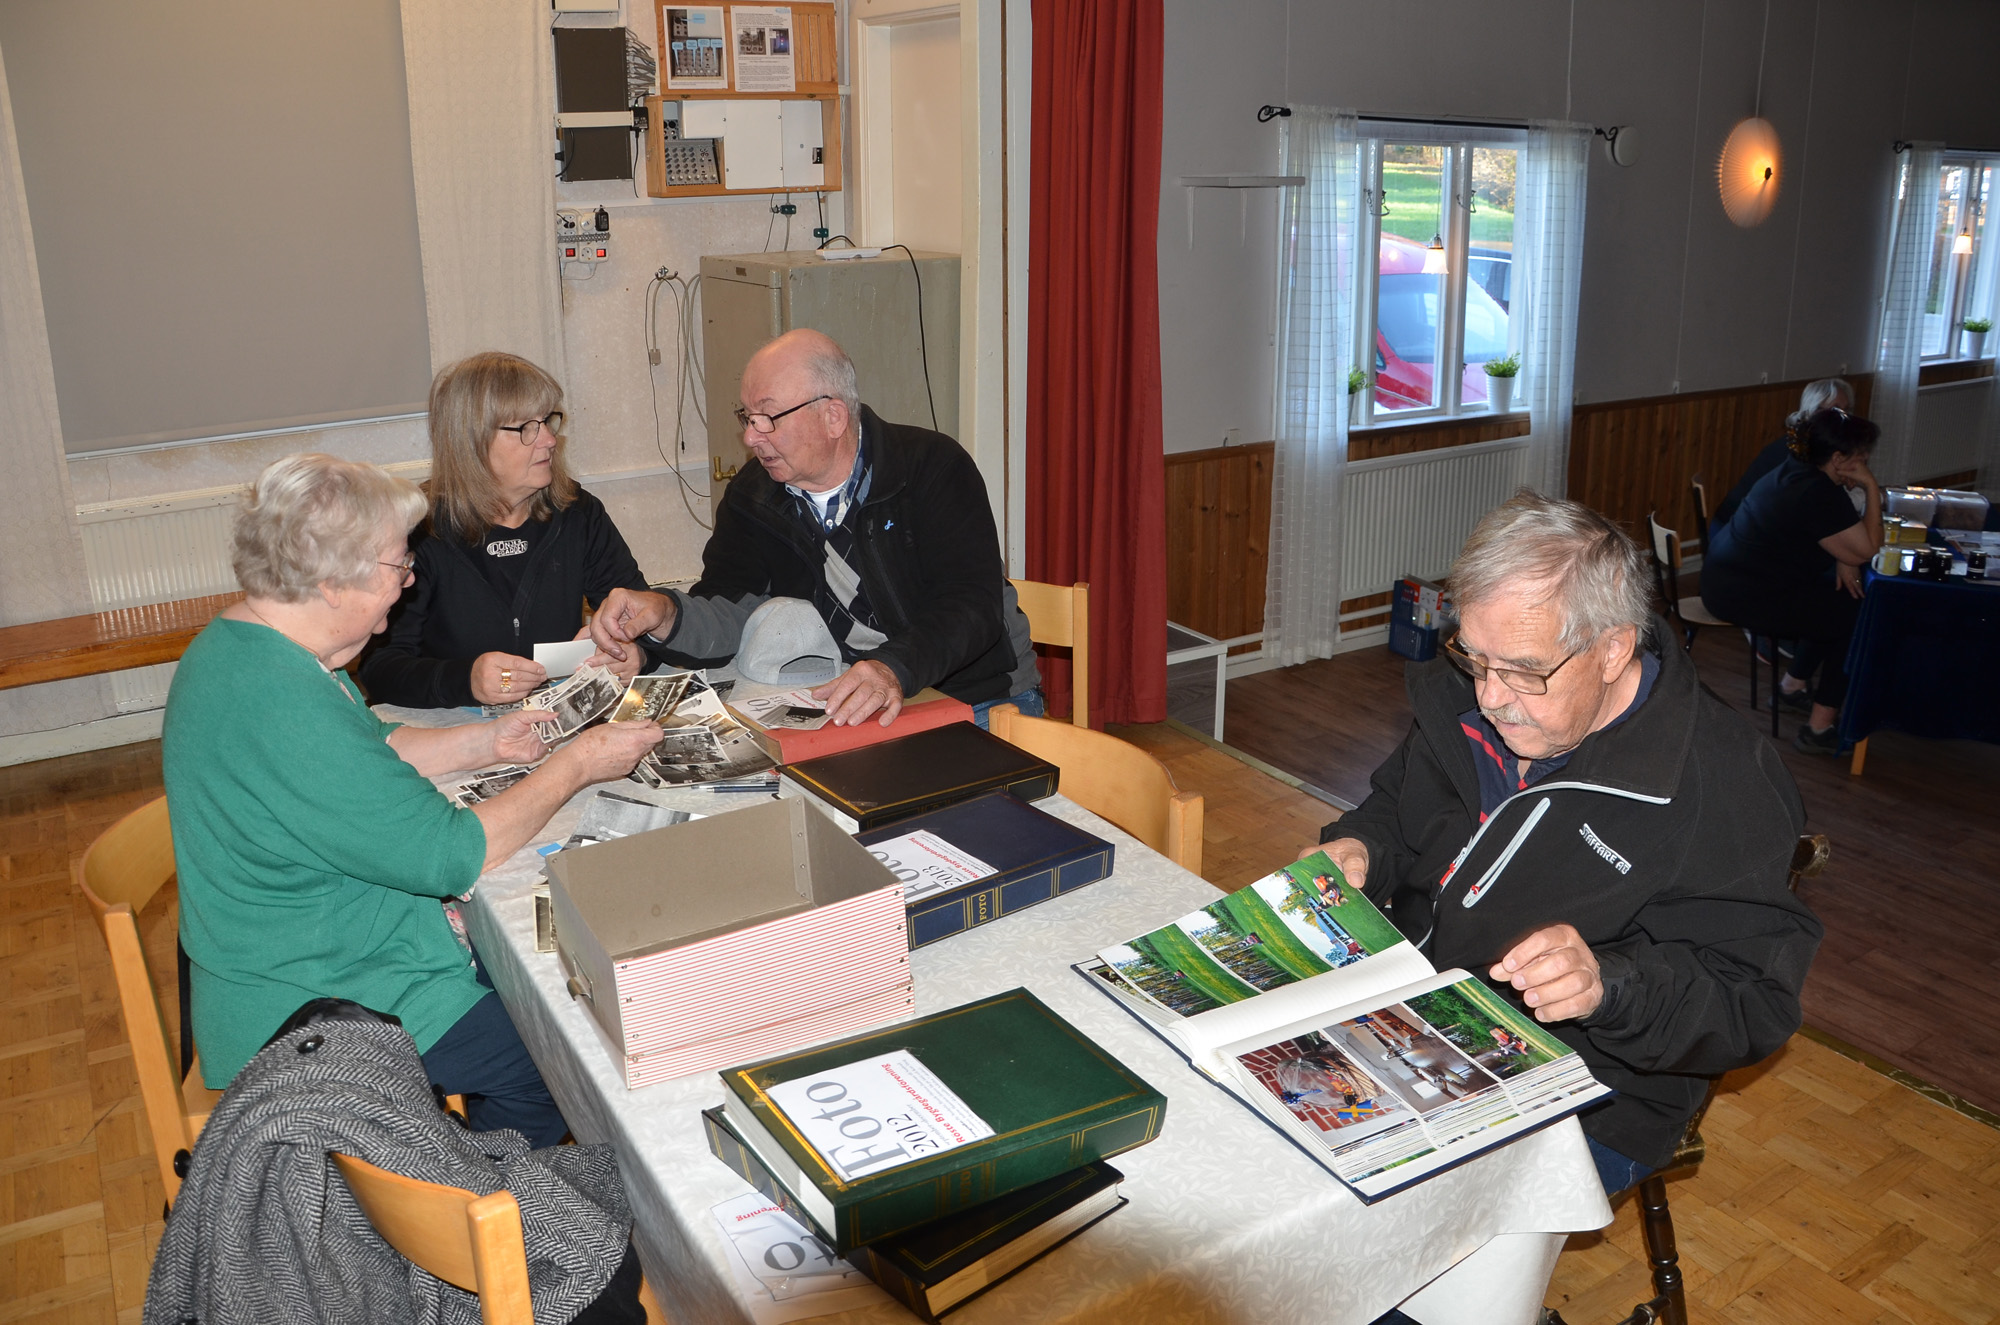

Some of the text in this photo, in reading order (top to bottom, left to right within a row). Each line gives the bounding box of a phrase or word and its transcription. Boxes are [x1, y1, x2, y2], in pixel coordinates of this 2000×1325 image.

[1578, 823, 1617, 865] STAFFARE
[922, 865, 963, 886] 2013
[979, 894, 987, 921] FOTO
[881, 1063, 945, 1123] Bygdegårdsförening
[806, 1081, 912, 1177] Foto
[886, 1113, 940, 1153] 2012
[943, 1122, 966, 1144] Röste
